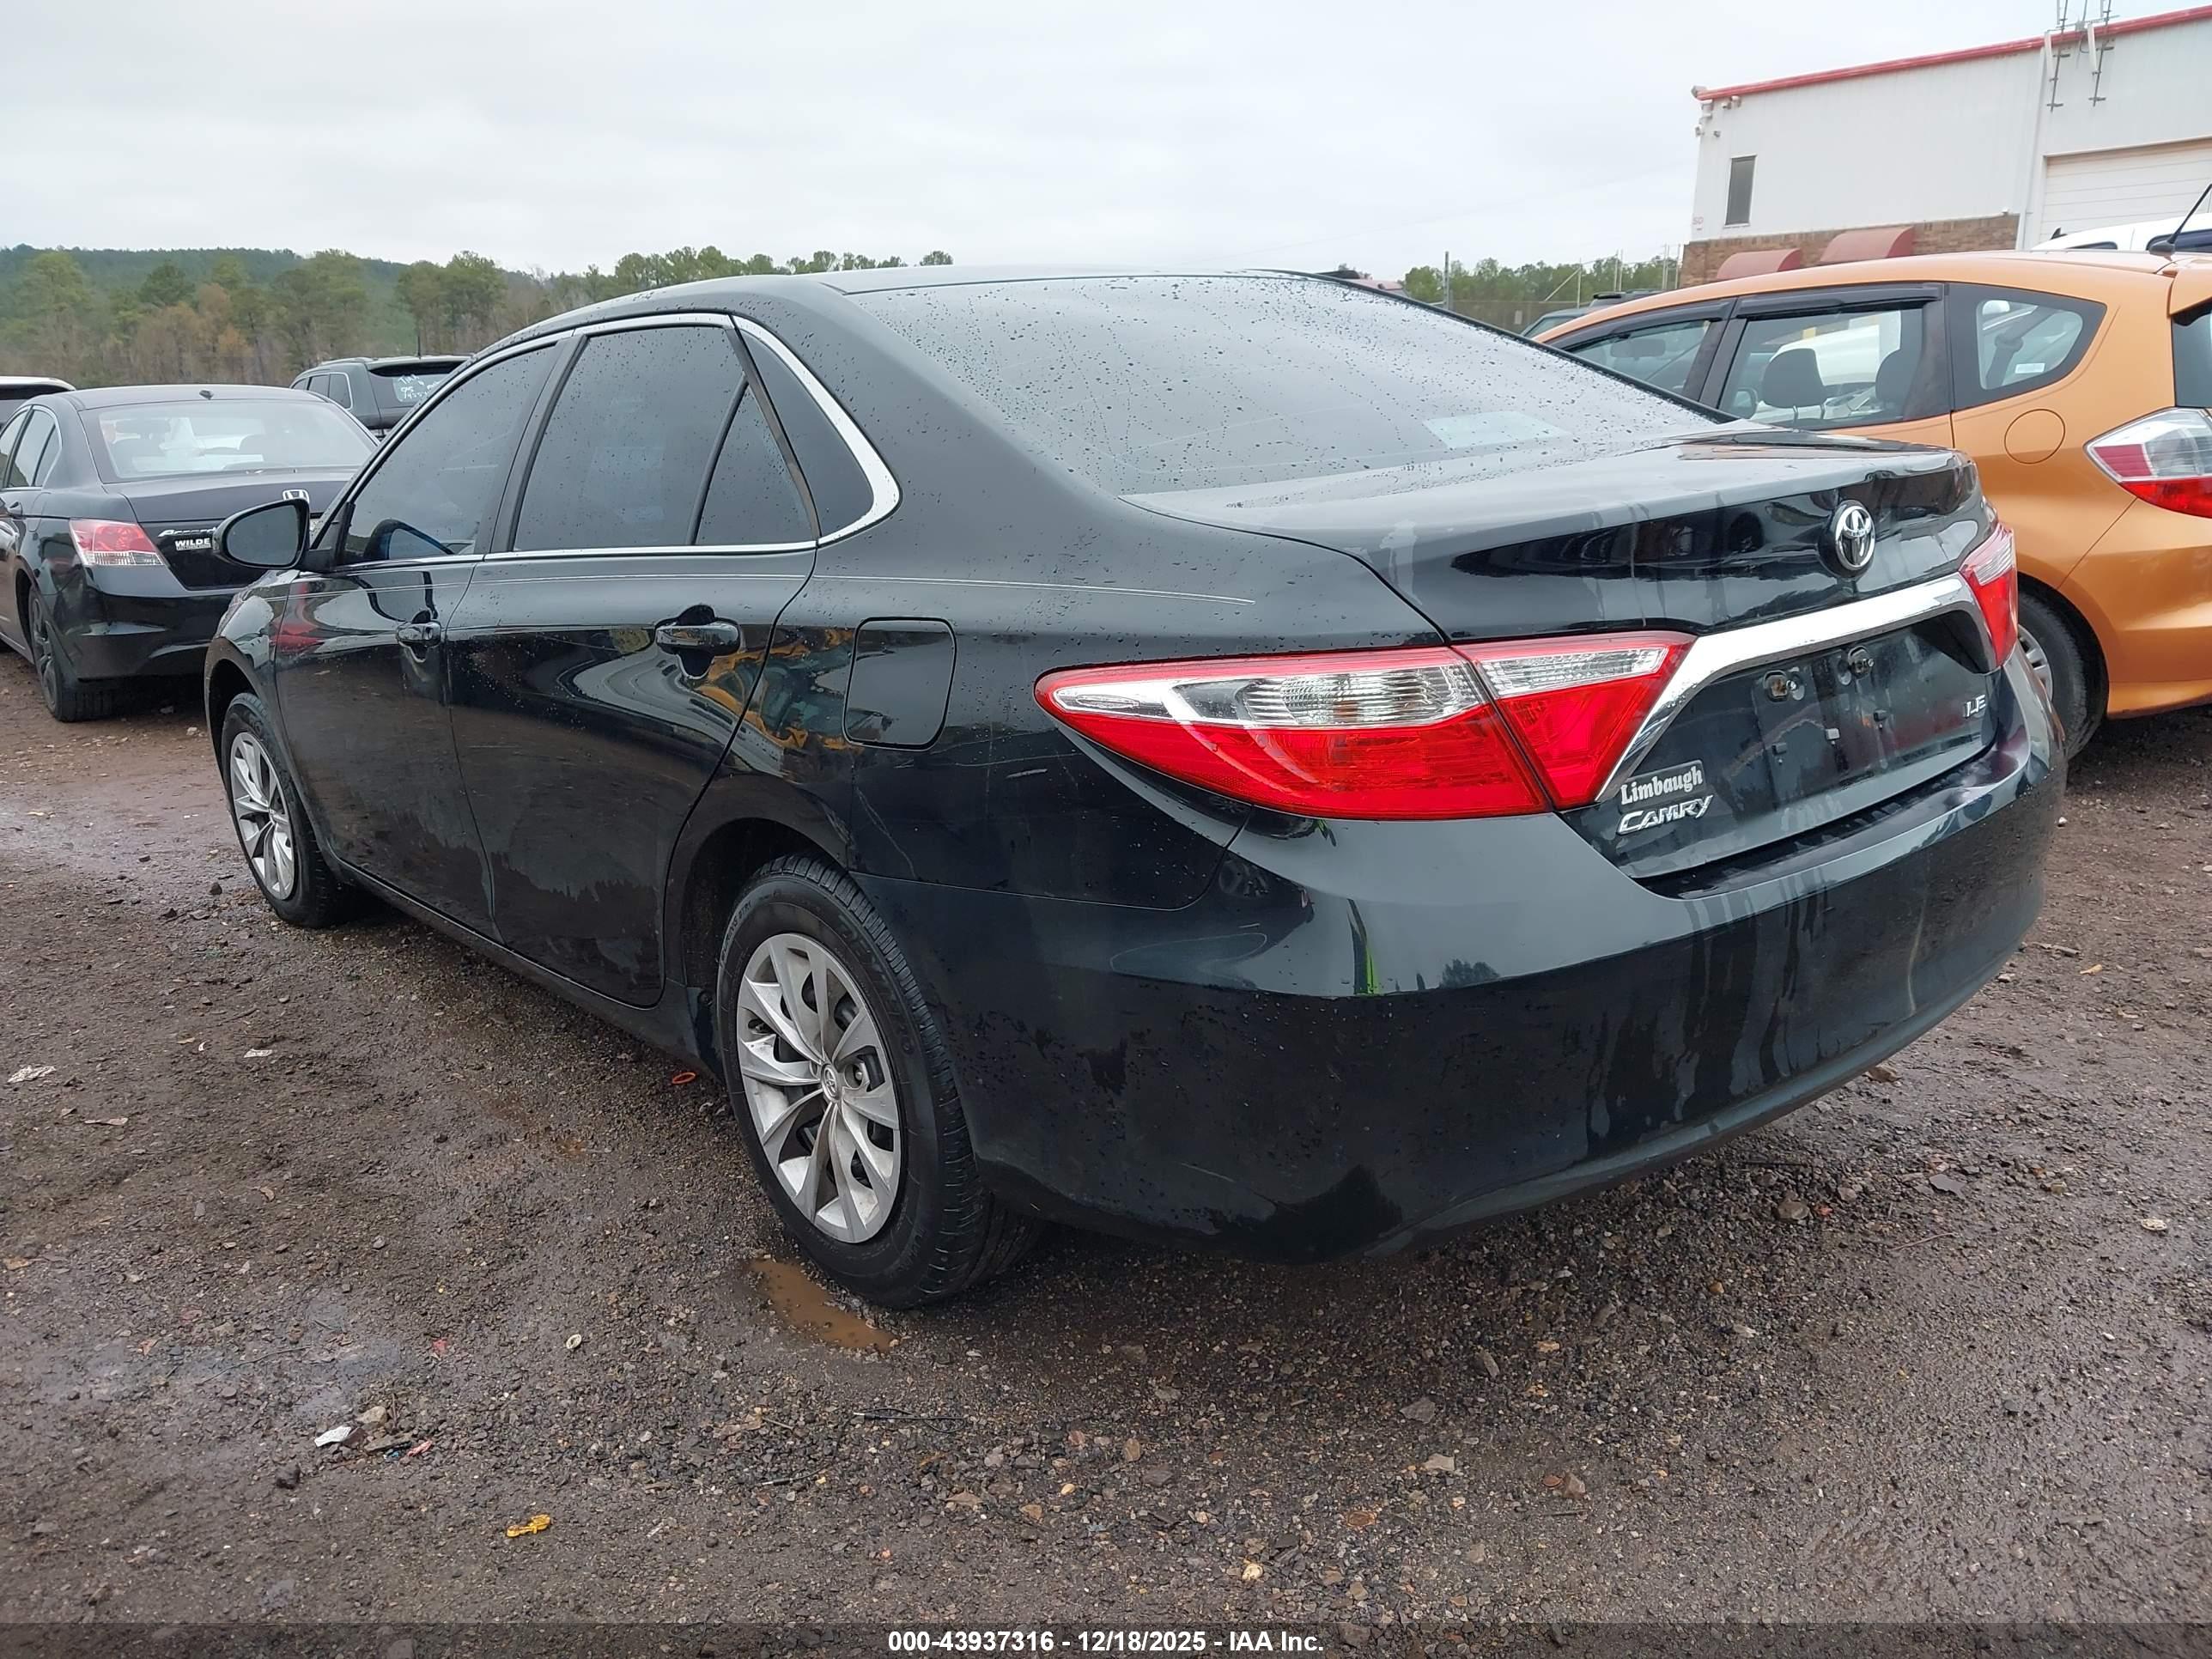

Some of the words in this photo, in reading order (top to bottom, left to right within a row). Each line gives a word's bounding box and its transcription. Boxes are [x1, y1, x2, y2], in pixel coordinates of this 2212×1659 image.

[174, 538, 210, 548] WILDE
[1965, 694, 1986, 717] LE
[1620, 765, 1704, 805] Limbaugh
[1616, 794, 1714, 836] CAMRY
